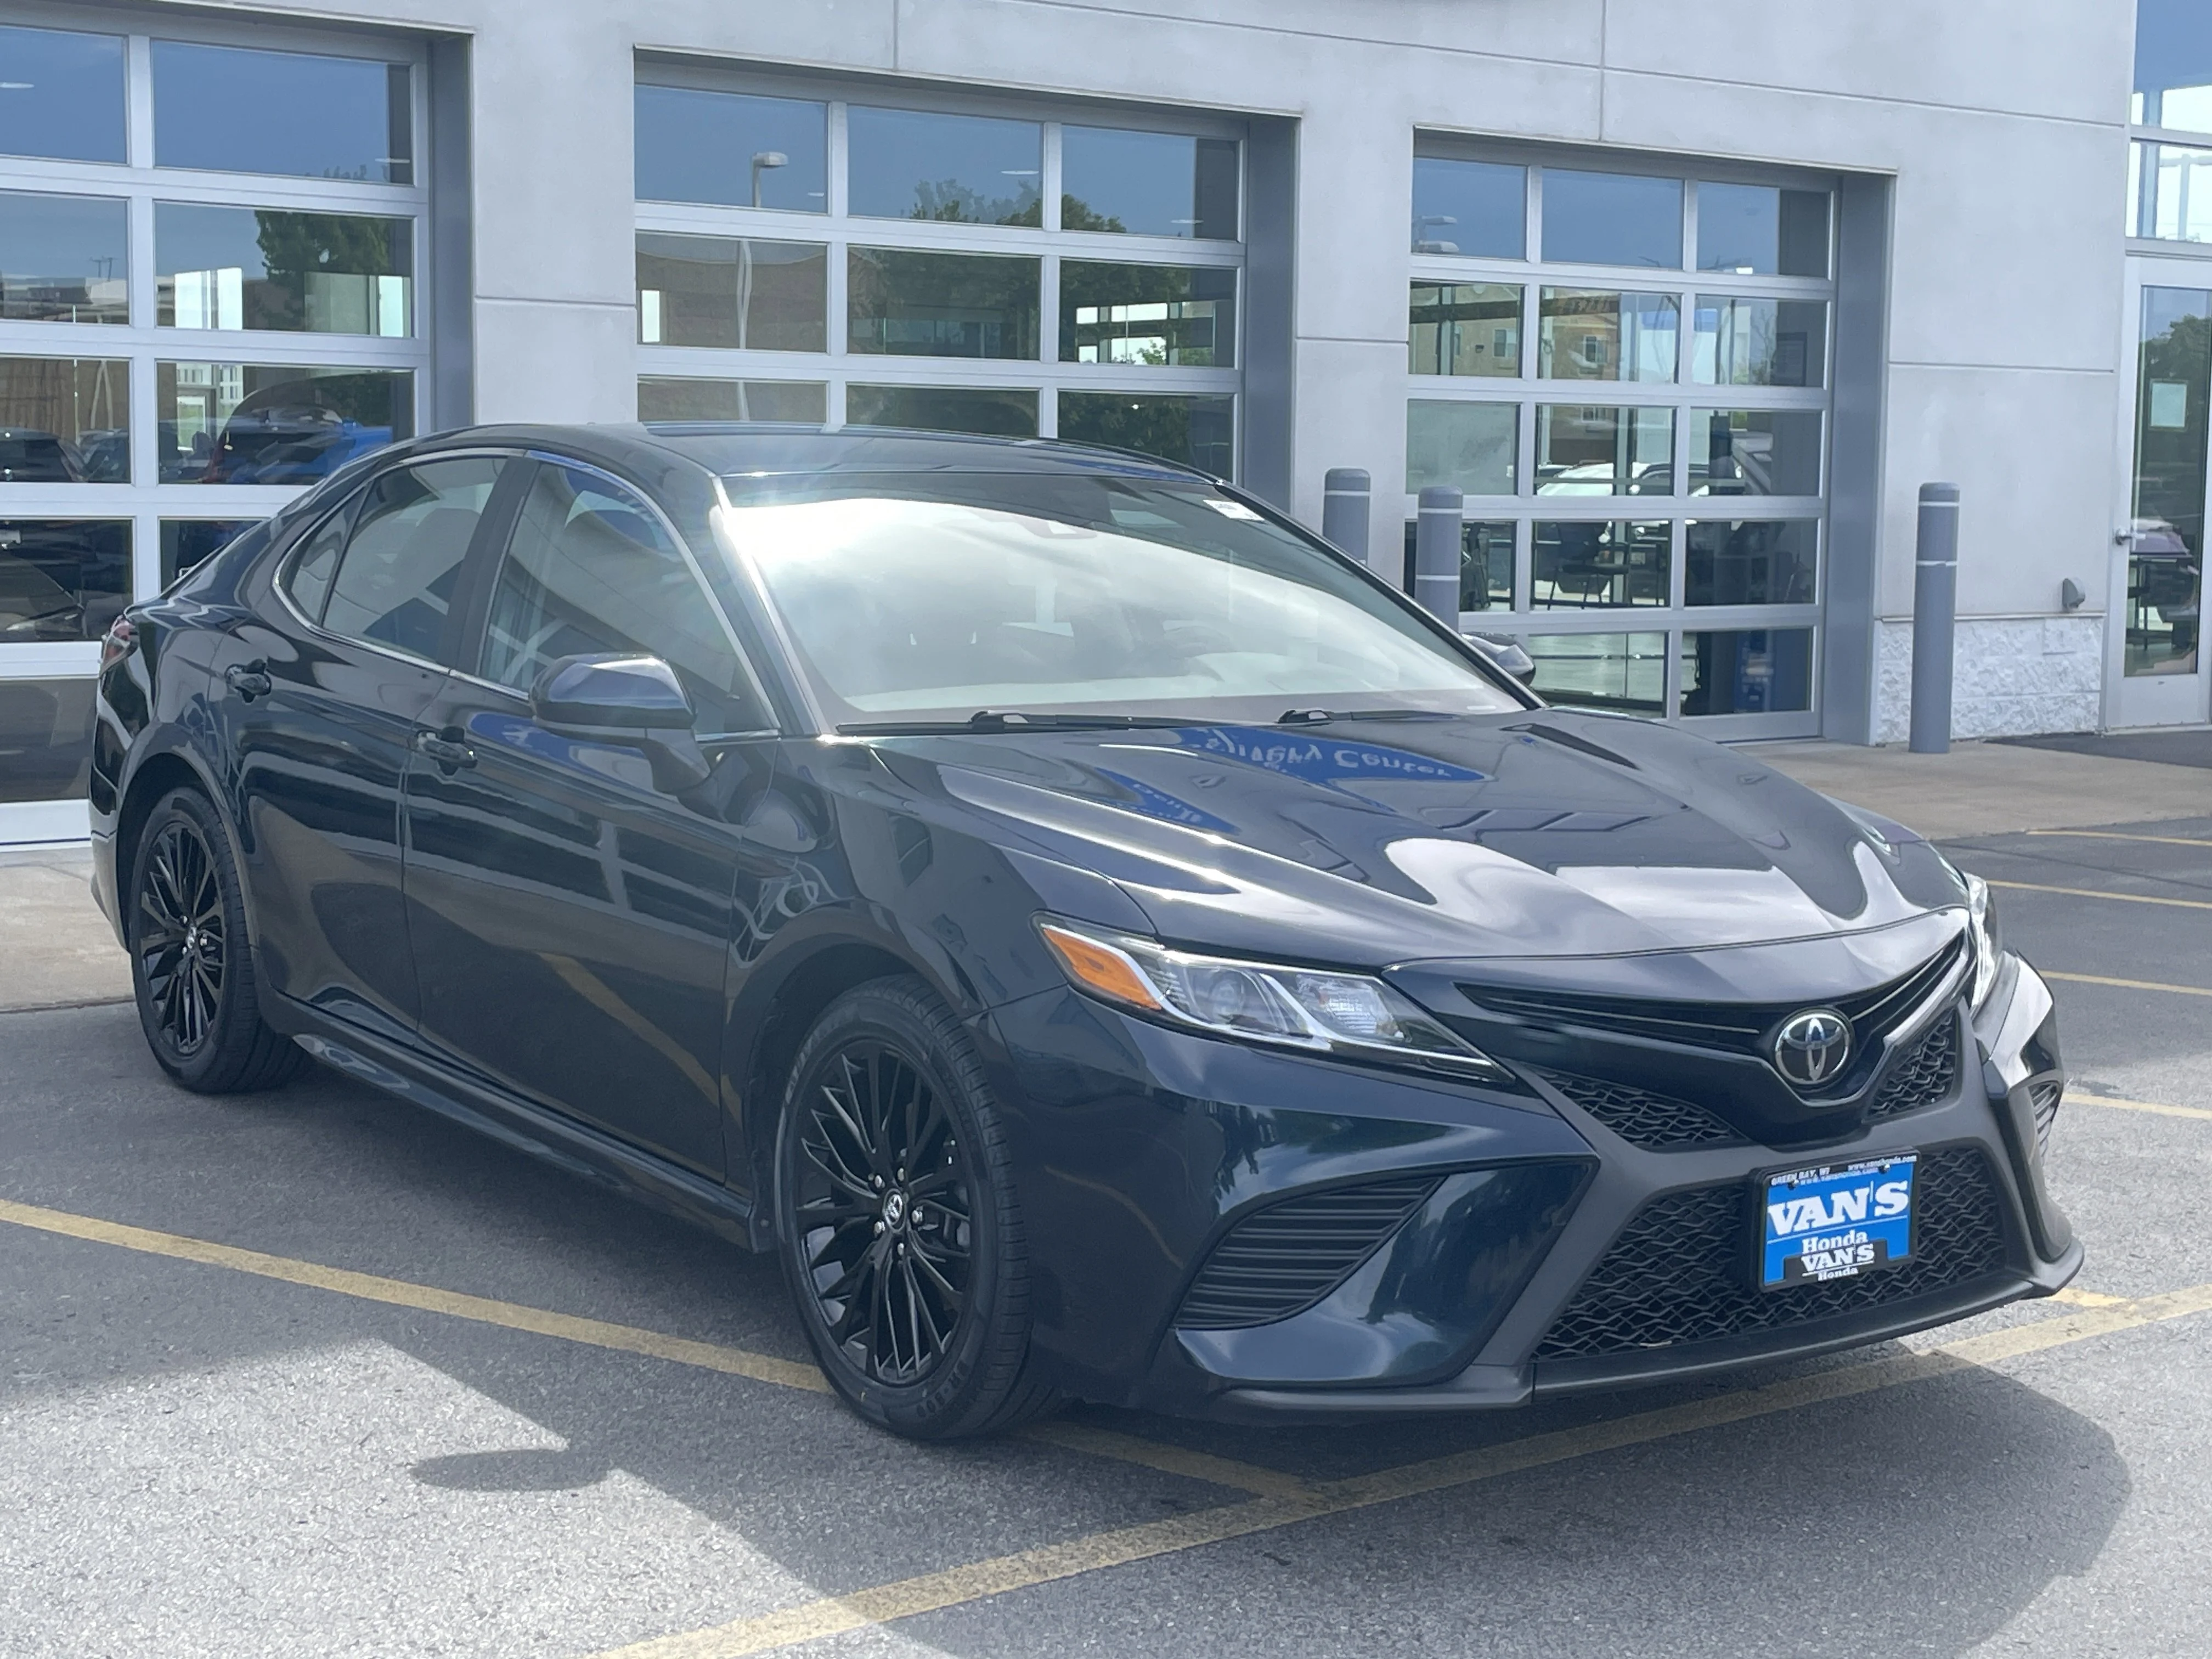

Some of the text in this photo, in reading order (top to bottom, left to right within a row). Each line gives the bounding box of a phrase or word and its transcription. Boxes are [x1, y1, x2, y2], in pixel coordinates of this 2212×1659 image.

[1767, 1180, 1909, 1235] VAN'S
[1802, 1229, 1868, 1254] Honda
[1801, 1243, 1875, 1272] VAN'S
[1817, 1266, 1859, 1282] Honda
